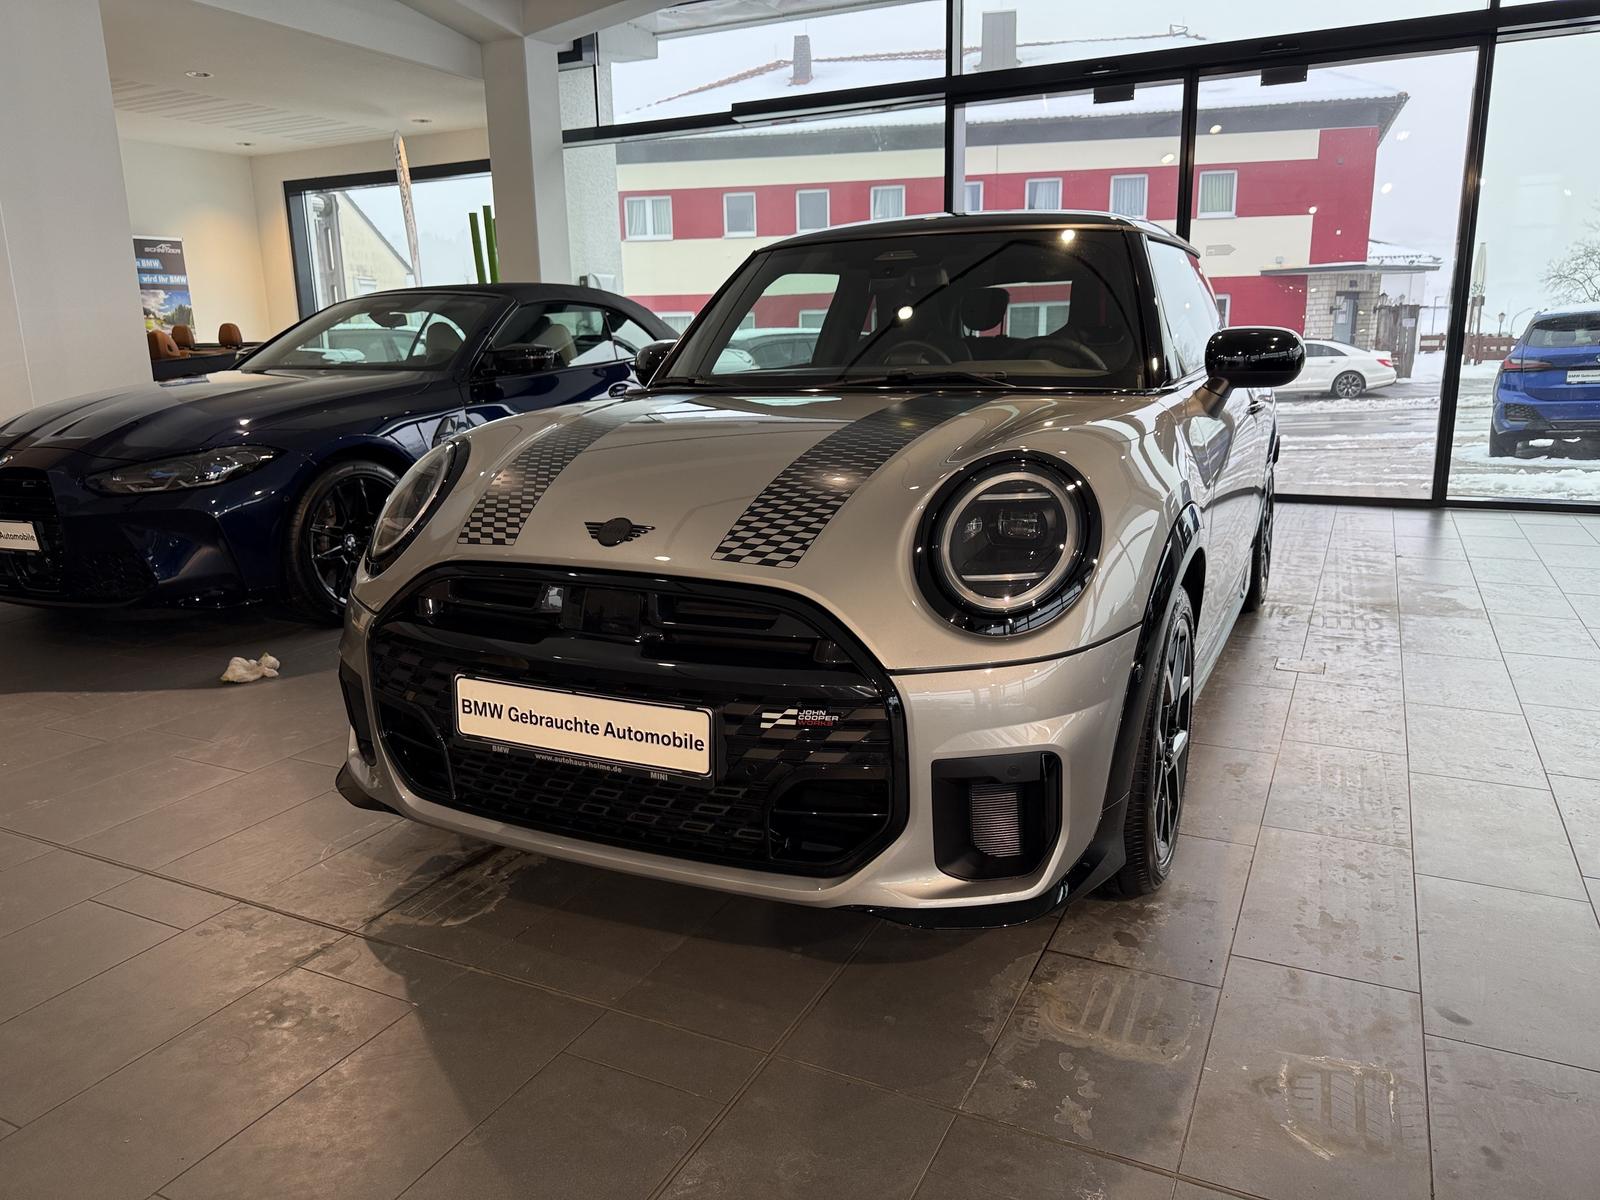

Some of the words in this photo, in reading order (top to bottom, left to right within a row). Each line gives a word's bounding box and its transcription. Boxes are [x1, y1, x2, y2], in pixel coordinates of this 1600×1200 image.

[141, 259, 159, 267] BMW
[142, 275, 157, 283] wird
[158, 275, 168, 283] Ihr
[169, 275, 187, 283] BMW
[461, 698, 504, 719] BMW
[508, 706, 600, 736] Gebrauchte
[604, 721, 705, 751] Automobile
[492, 745, 509, 754] BMW
[535, 752, 622, 773] www.autohaus-holme.de
[650, 771, 668, 781] MINI
